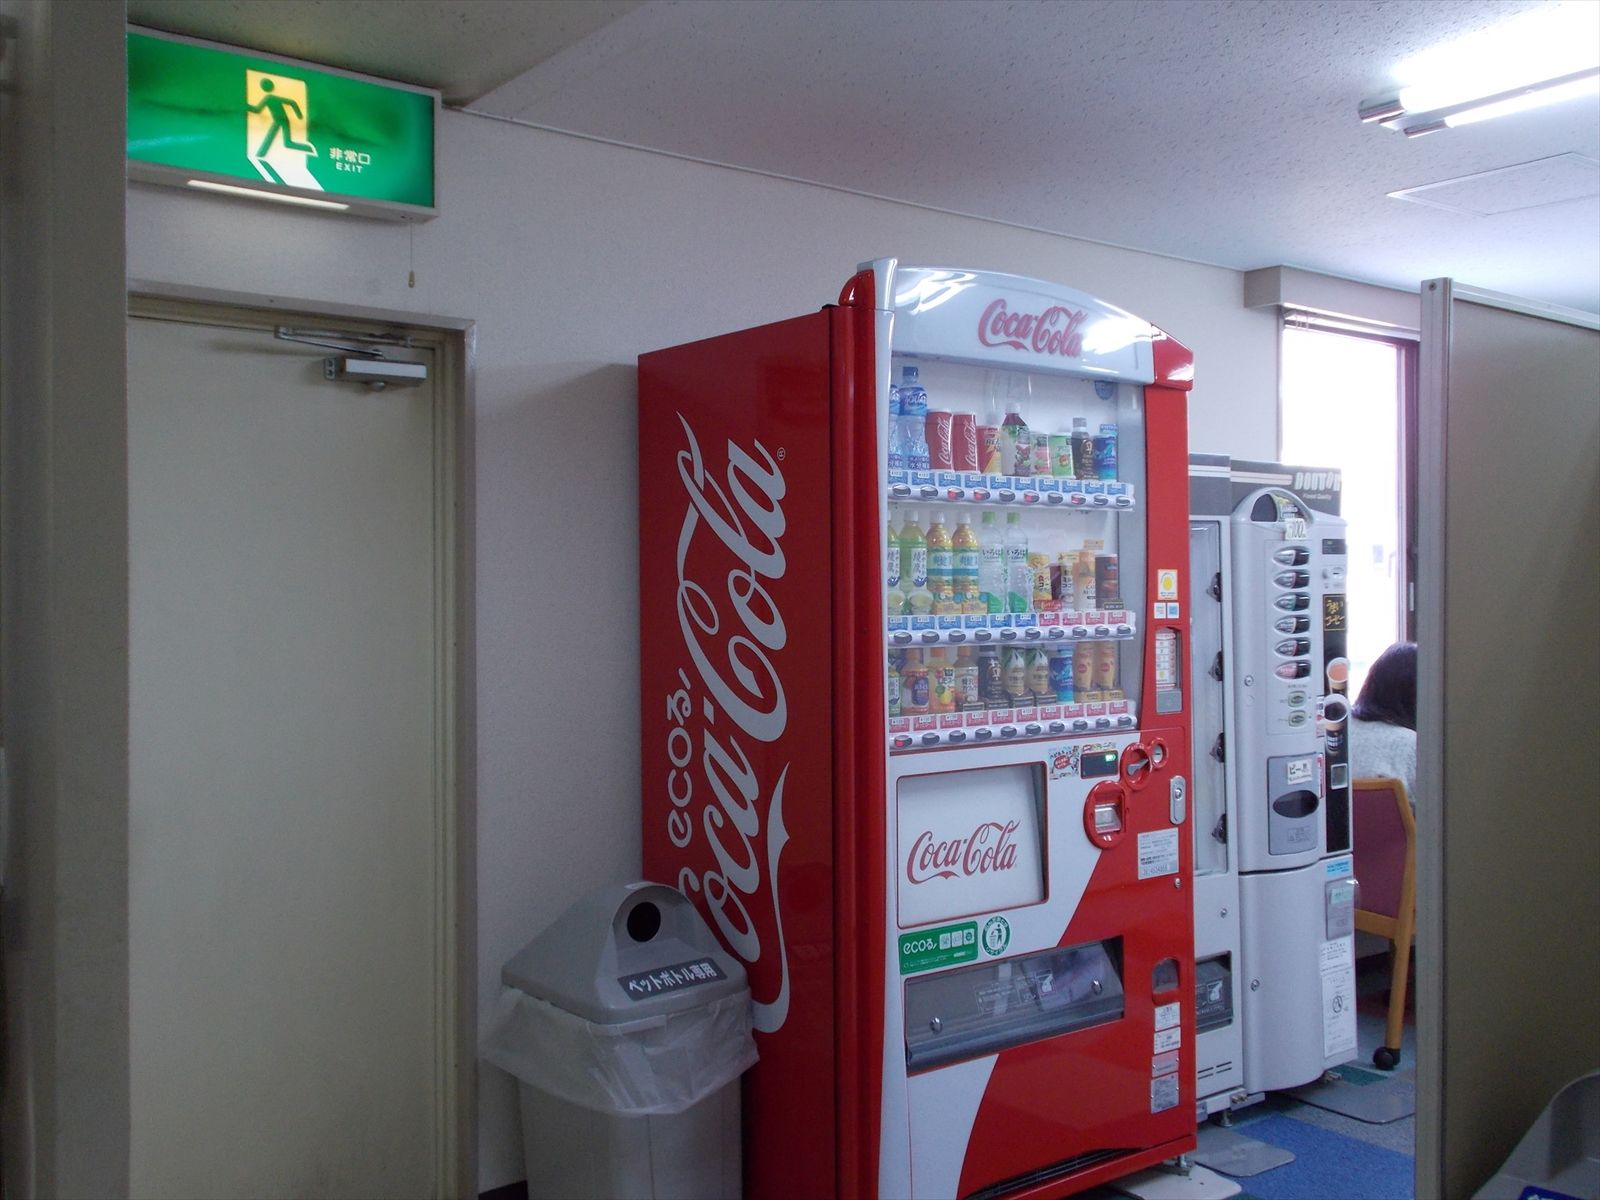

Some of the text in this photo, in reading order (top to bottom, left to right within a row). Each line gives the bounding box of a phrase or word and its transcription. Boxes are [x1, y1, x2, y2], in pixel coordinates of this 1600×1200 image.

[329, 147, 371, 165] 非常口
[336, 161, 363, 173] EXIT
[978, 299, 1088, 358] Coca-Cola
[1294, 471, 1342, 491] DOUTOR
[675, 411, 792, 1034] Coca-Cola
[906, 820, 1021, 885] Coca-Cola
[628, 962, 718, 992] ペットボトル専用
